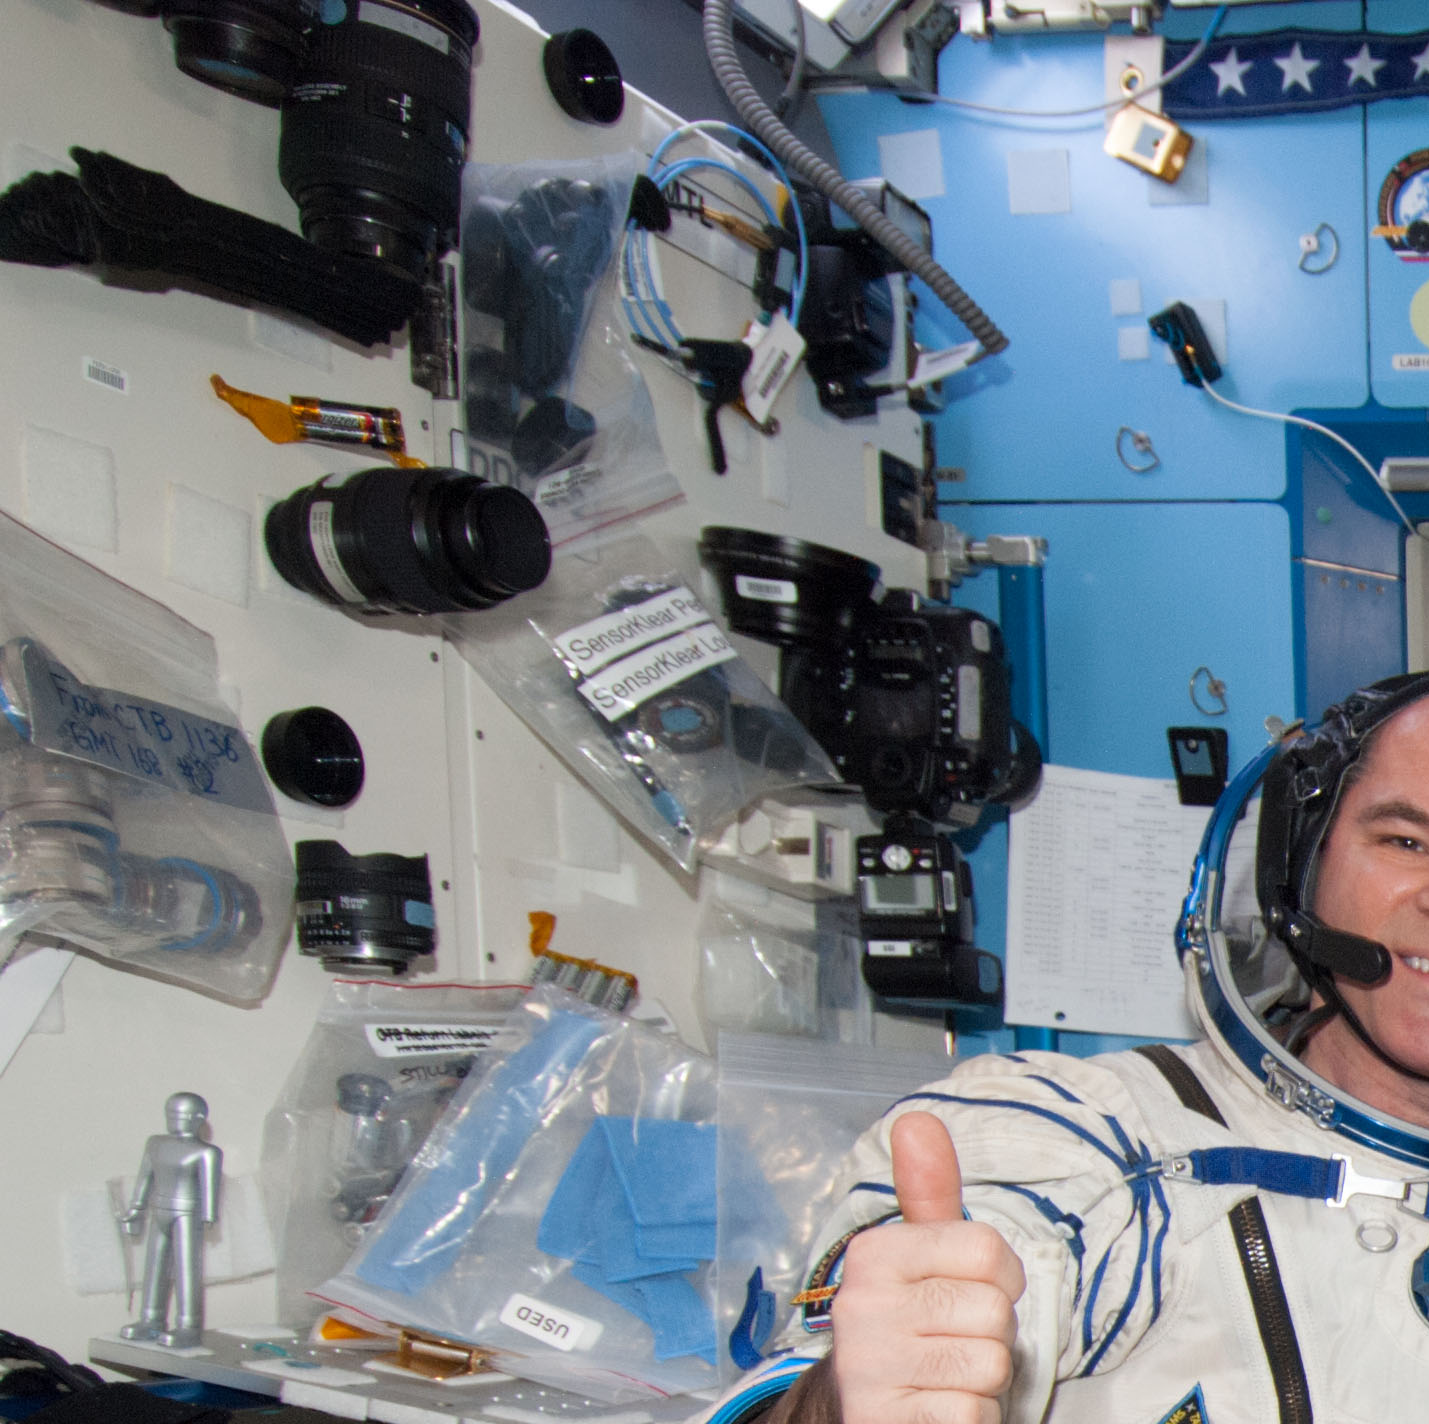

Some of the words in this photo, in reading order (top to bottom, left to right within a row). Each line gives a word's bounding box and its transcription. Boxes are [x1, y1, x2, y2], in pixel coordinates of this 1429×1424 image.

[569, 607, 676, 661] SensorKlear
[593, 642, 705, 709] SensorKlear
[516, 1305, 570, 1339] USED
